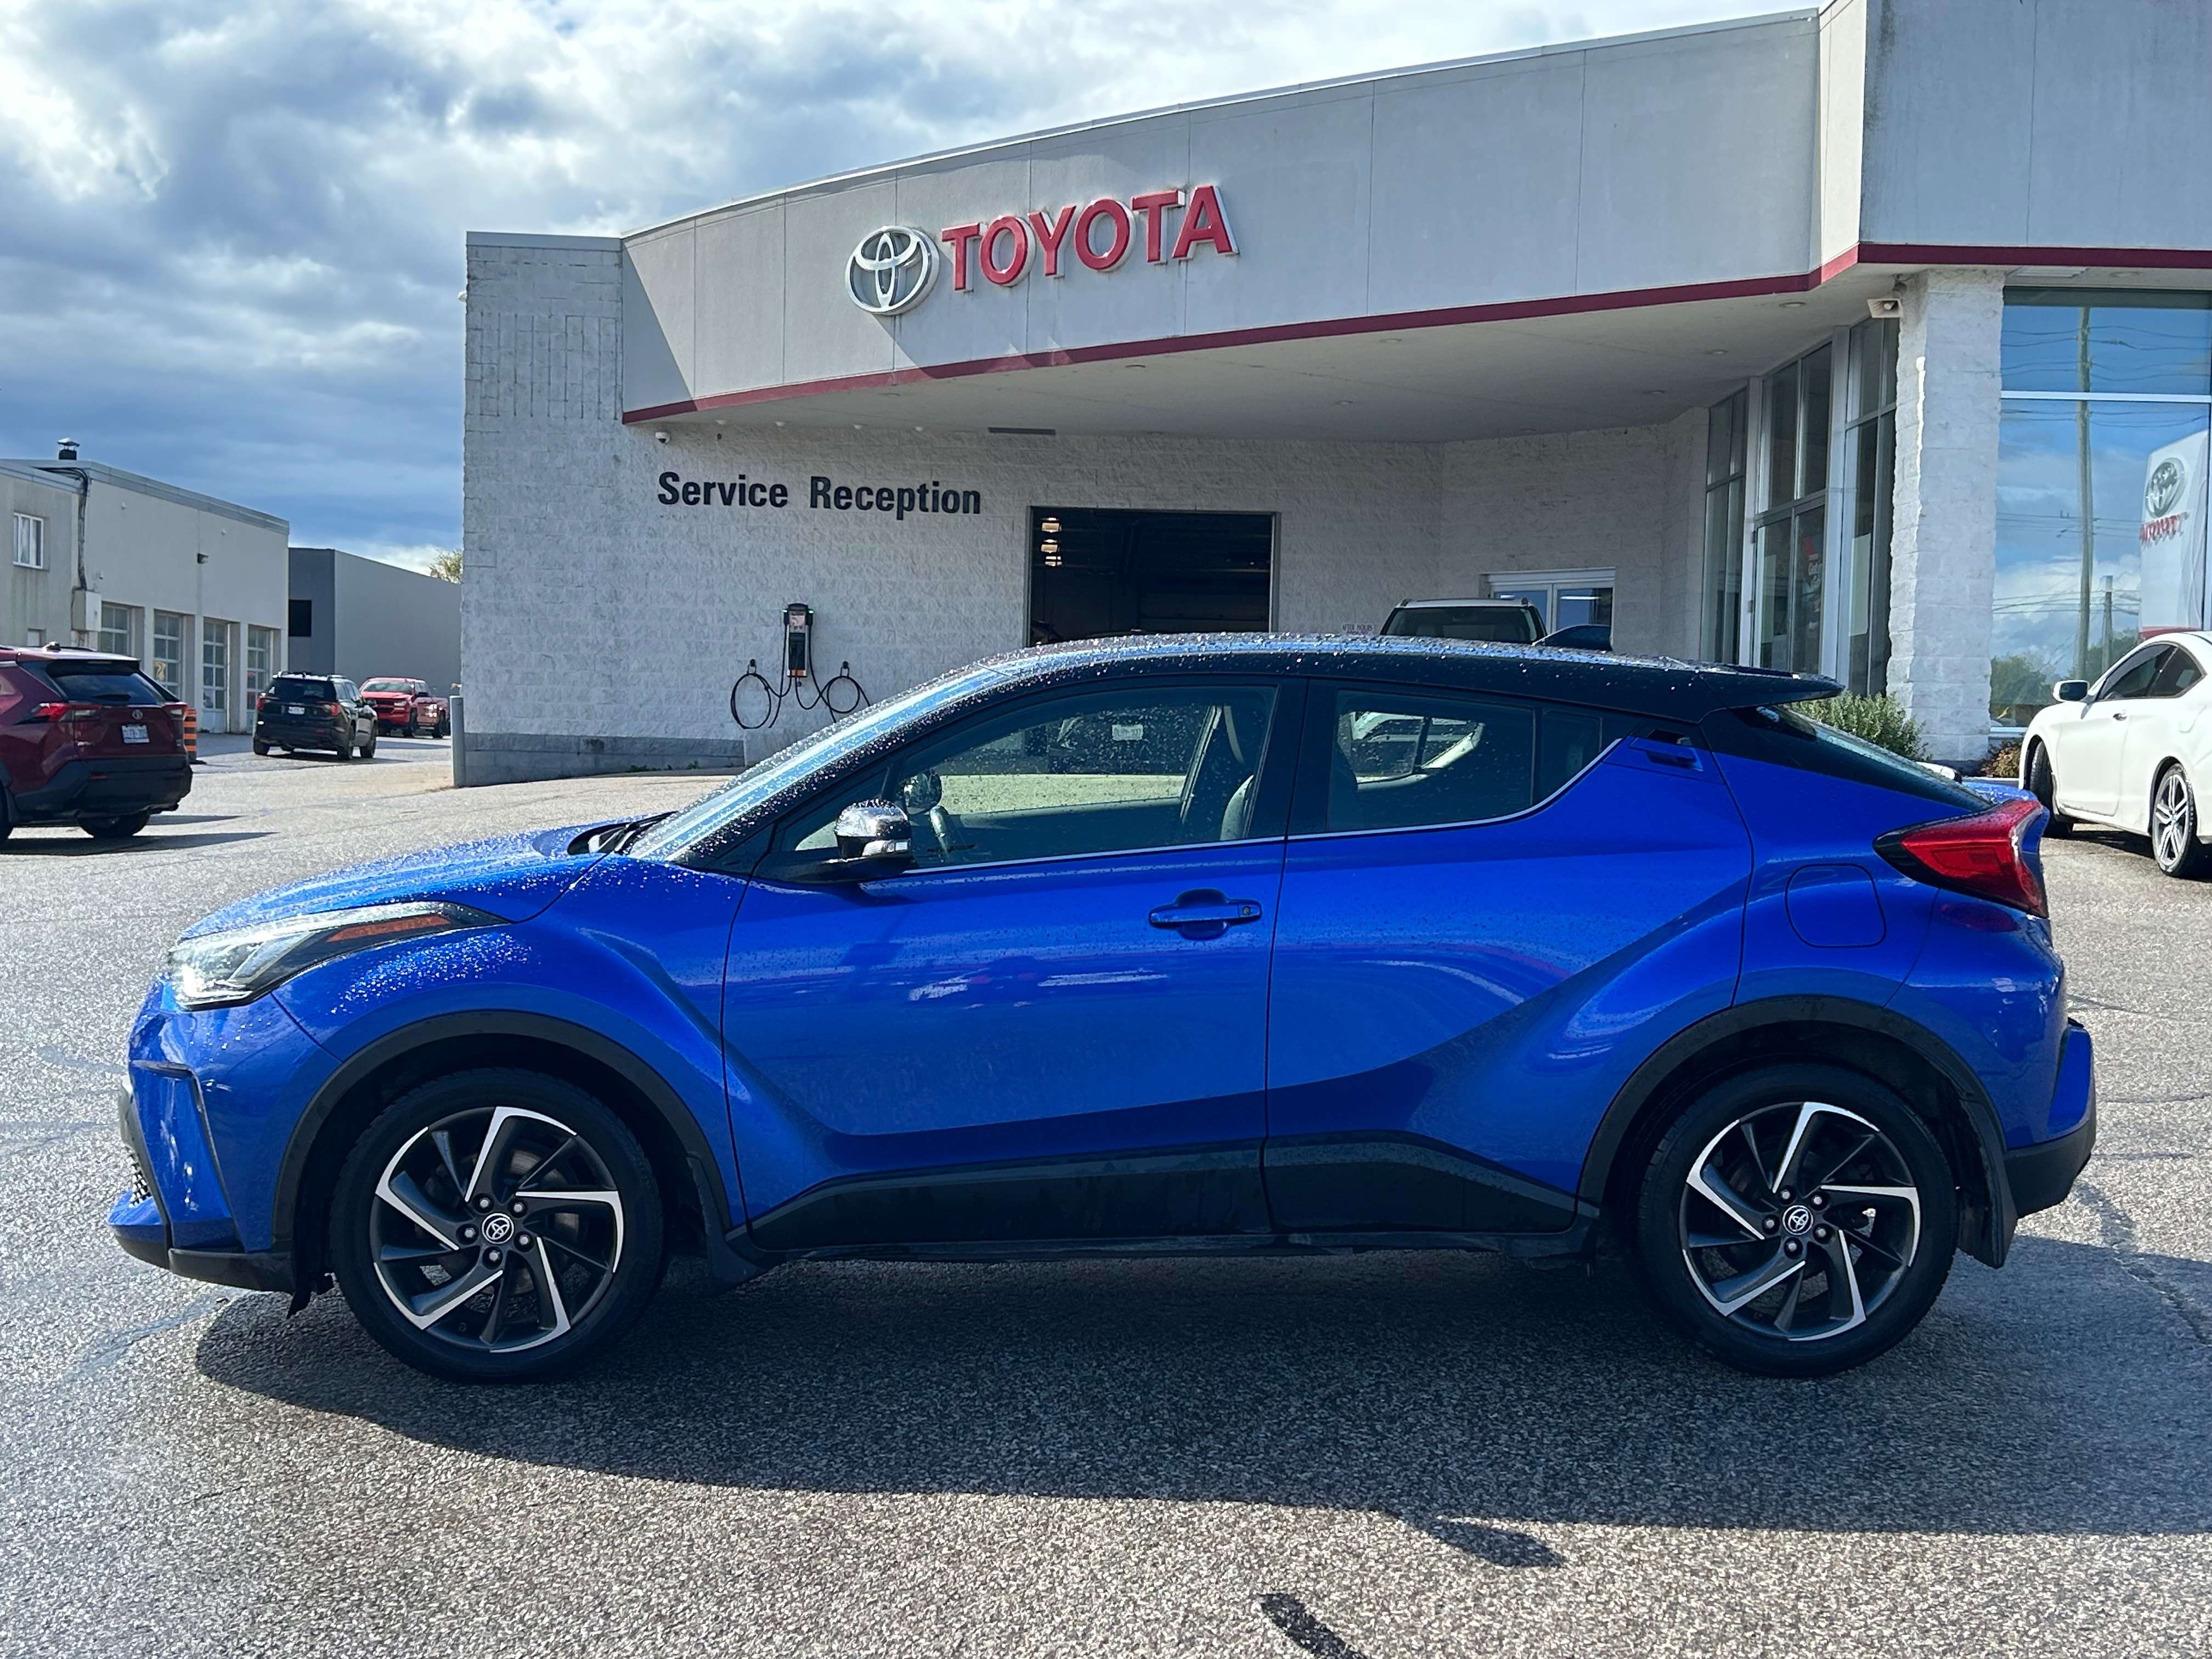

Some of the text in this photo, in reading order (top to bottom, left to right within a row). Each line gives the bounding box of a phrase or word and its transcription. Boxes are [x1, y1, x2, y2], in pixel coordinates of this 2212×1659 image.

[941, 185, 1239, 292] TOYOTA
[658, 472, 981, 521] Service Reception
